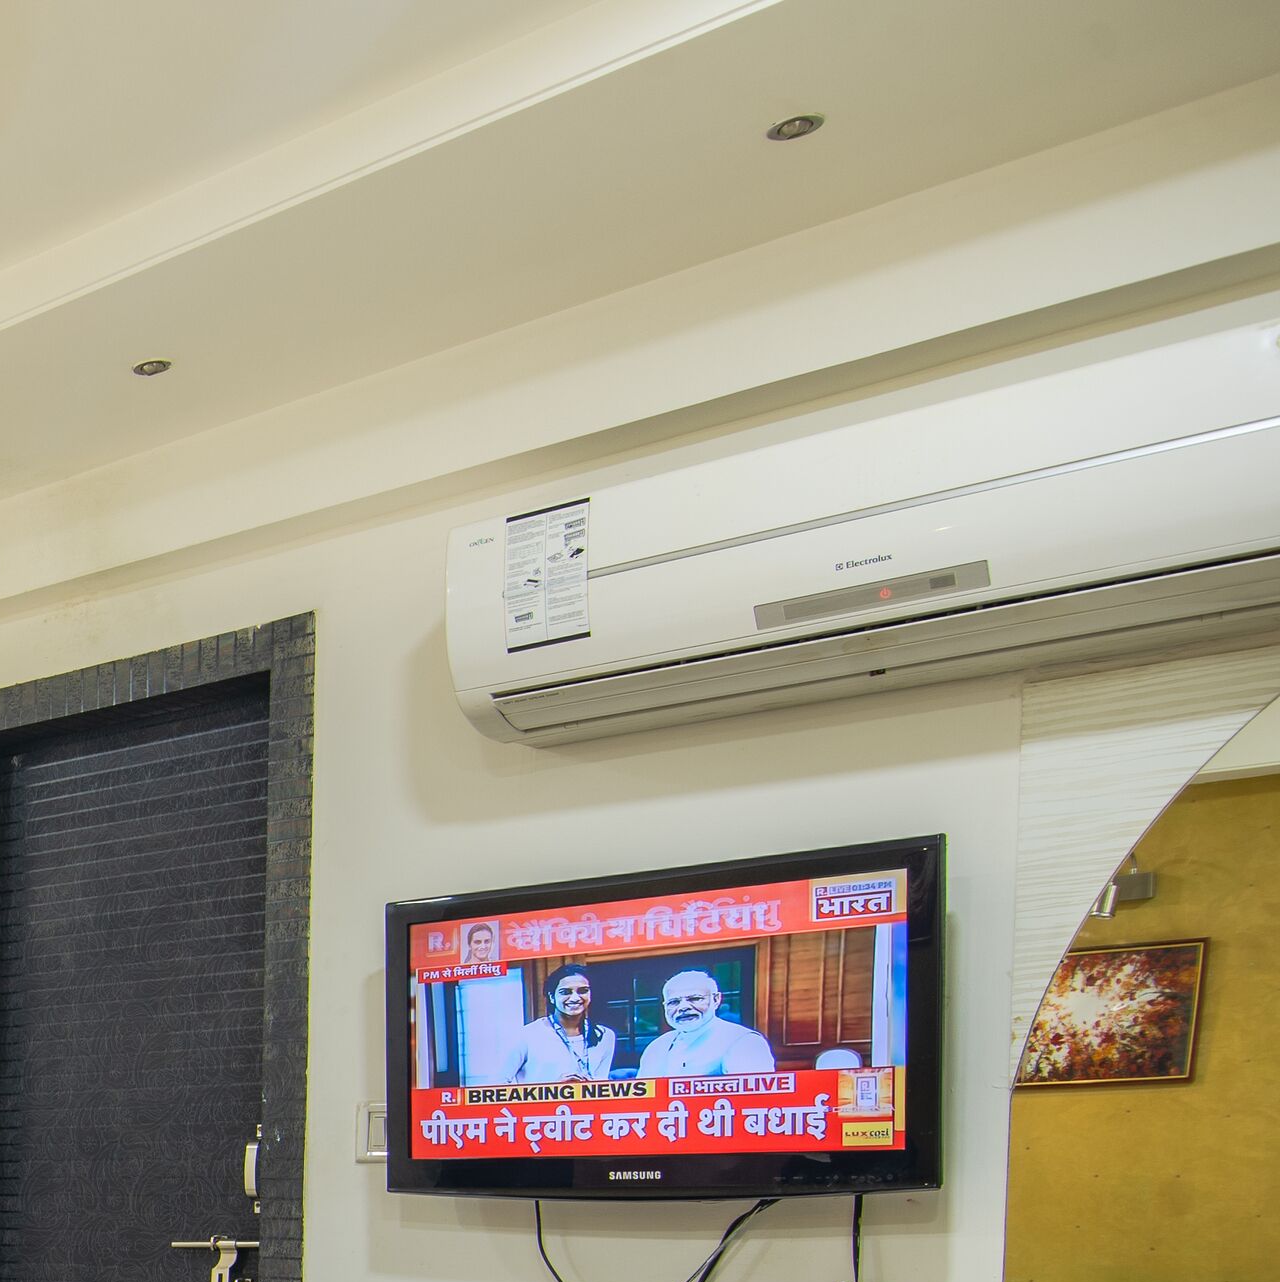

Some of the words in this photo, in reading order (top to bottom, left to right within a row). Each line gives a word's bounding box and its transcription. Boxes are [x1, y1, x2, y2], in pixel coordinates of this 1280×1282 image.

[846, 554, 893, 569] Electrolux
[878, 881, 892, 889] PM
[818, 893, 891, 916] भारत
[423, 971, 440, 980] PM
[442, 967, 452, 978] से
[468, 1085, 575, 1104] BREAKING
[581, 1081, 648, 1100] NEWS
[694, 1080, 739, 1094] भारत
[743, 1076, 791, 1092] LIVE
[420, 1109, 488, 1149] पीएम
[493, 1107, 518, 1143] ने
[522, 1104, 595, 1153] ट्वीट
[600, 1111, 650, 1139] कर
[656, 1100, 689, 1142] दी
[697, 1098, 736, 1137] थी
[741, 1093, 831, 1141] बधाई
[608, 1171, 662, 1181] SAMSUNG
